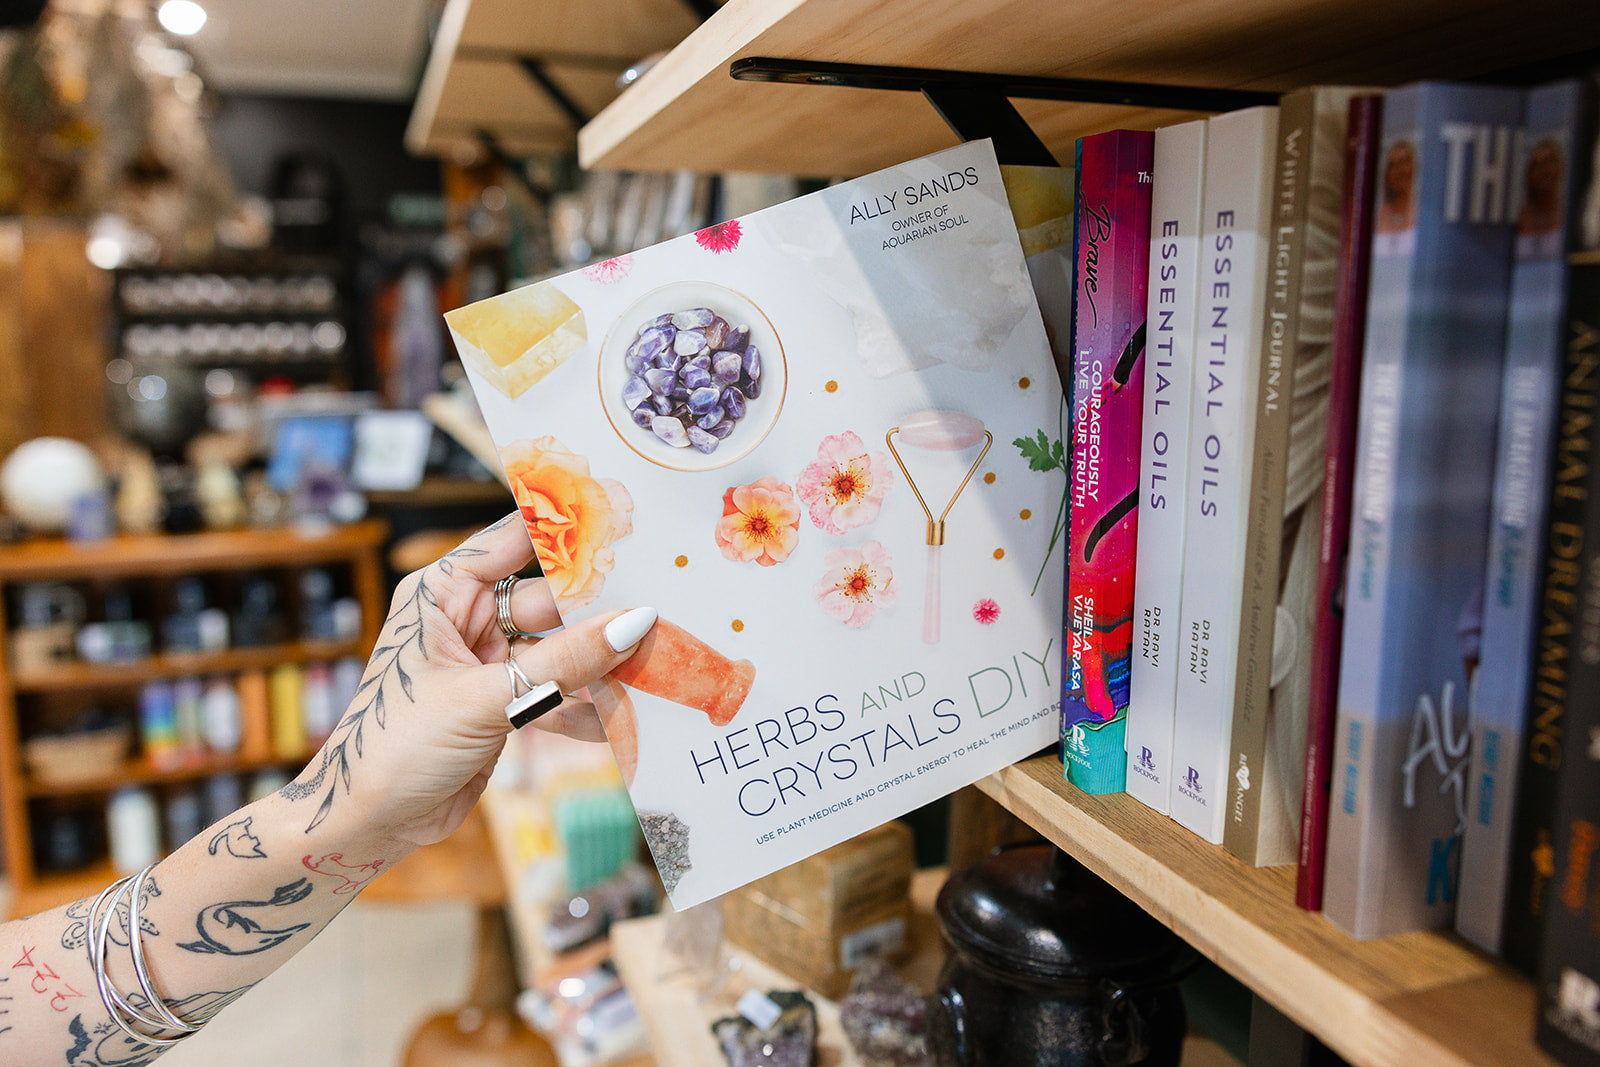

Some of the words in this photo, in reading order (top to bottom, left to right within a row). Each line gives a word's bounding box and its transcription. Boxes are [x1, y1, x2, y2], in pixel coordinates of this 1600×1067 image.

[850, 190, 898, 225] ALLY
[905, 166, 979, 206] SANDS
[891, 210, 932, 232] OWNER
[930, 204, 949, 219] OF
[882, 226, 938, 251] AQUARIAN
[938, 214, 968, 232] SOUL
[1081, 190, 1111, 328] Brave
[1274, 226, 1295, 303] LIGHT
[1154, 220, 1179, 416] ESSENTIAL
[1206, 210, 1234, 417] ESSENTIAL
[1078, 350, 1089, 390] LIVE
[1265, 308, 1288, 416] JOURNAL
[1077, 395, 1088, 445] YOUR
[1088, 359, 1102, 502] COURAGEOUSLY
[1553, 319, 1600, 506] ANIMAL
[1075, 447, 1087, 508] TRUTH
[1151, 431, 1169, 510] OILS
[1200, 434, 1221, 517] OILS
[1071, 594, 1083, 691] VIJEYARASA
[1082, 596, 1094, 652] SHEILA
[1142, 608, 1151, 658] RATAN
[1152, 606, 1161, 627] DR
[1201, 619, 1211, 641] DR
[1529, 520, 1586, 770] DREAMING
[1151, 633, 1160, 668] RAVI
[1190, 621, 1199, 674] RATAN
[1199, 648, 1209, 684] RAVI
[690, 693, 846, 785] HERBS
[860, 671, 926, 718] AND
[738, 698, 961, 818] CRYSTALS
[967, 638, 1053, 719] DIY
[756, 831, 775, 845] USE
[777, 817, 807, 836] PLANT
[808, 798, 854, 823] MEDICINE
[856, 788, 876, 803] AND
[877, 771, 916, 793] CRYSTAL
[917, 754, 951, 775] ENERGY
[953, 748, 966, 758] TO
[967, 739, 990, 753] HEAL
[990, 727, 1007, 741] THE
[1008, 717, 1030, 733] MIND
[1032, 708, 1050, 721] AND
[1133, 764, 1160, 784] ROCKPOOL
[1178, 784, 1207, 807] ROCKPOOL
